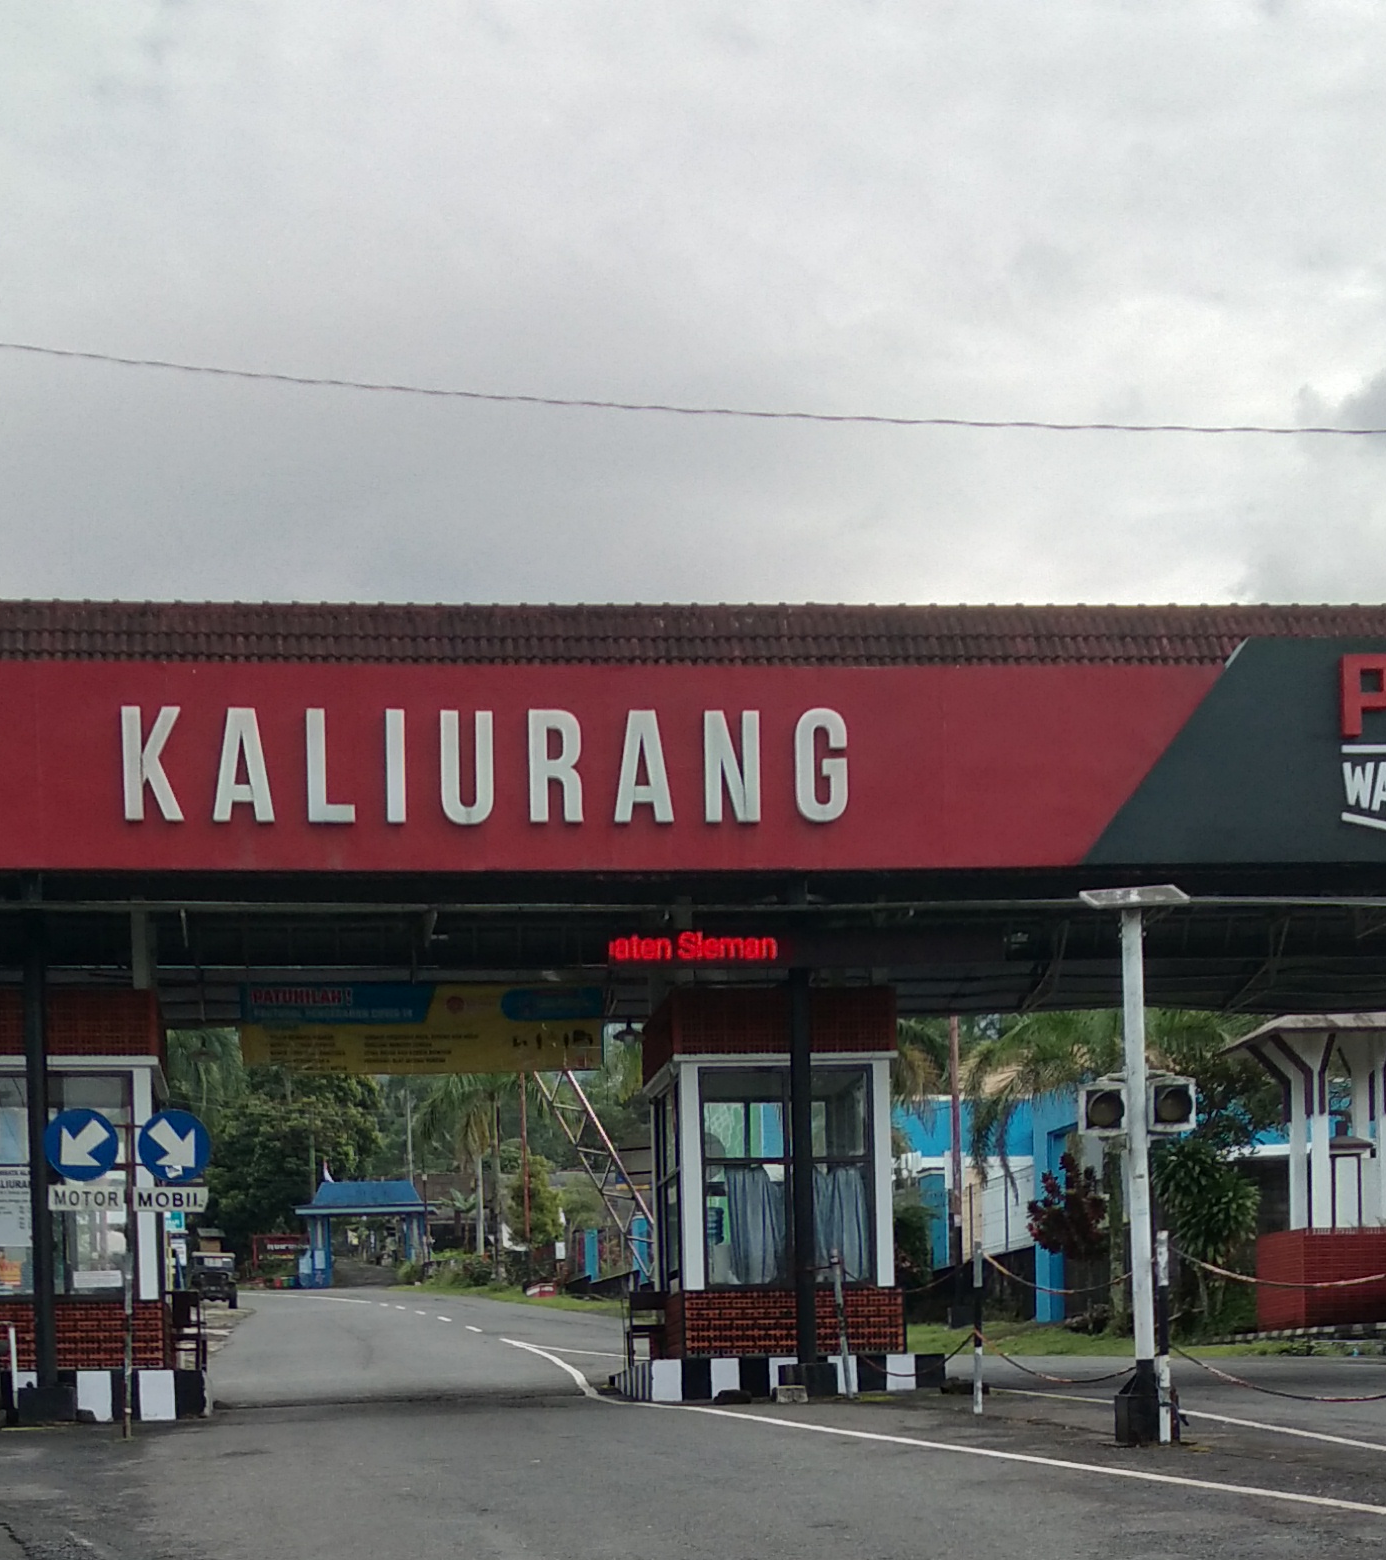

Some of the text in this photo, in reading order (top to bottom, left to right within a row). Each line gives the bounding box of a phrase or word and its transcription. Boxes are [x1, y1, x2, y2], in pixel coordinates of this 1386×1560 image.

[119, 705, 850, 826] KALIURANG
[677, 931, 778, 960] Sleman
[54, 1189, 119, 1207] MOTOR
